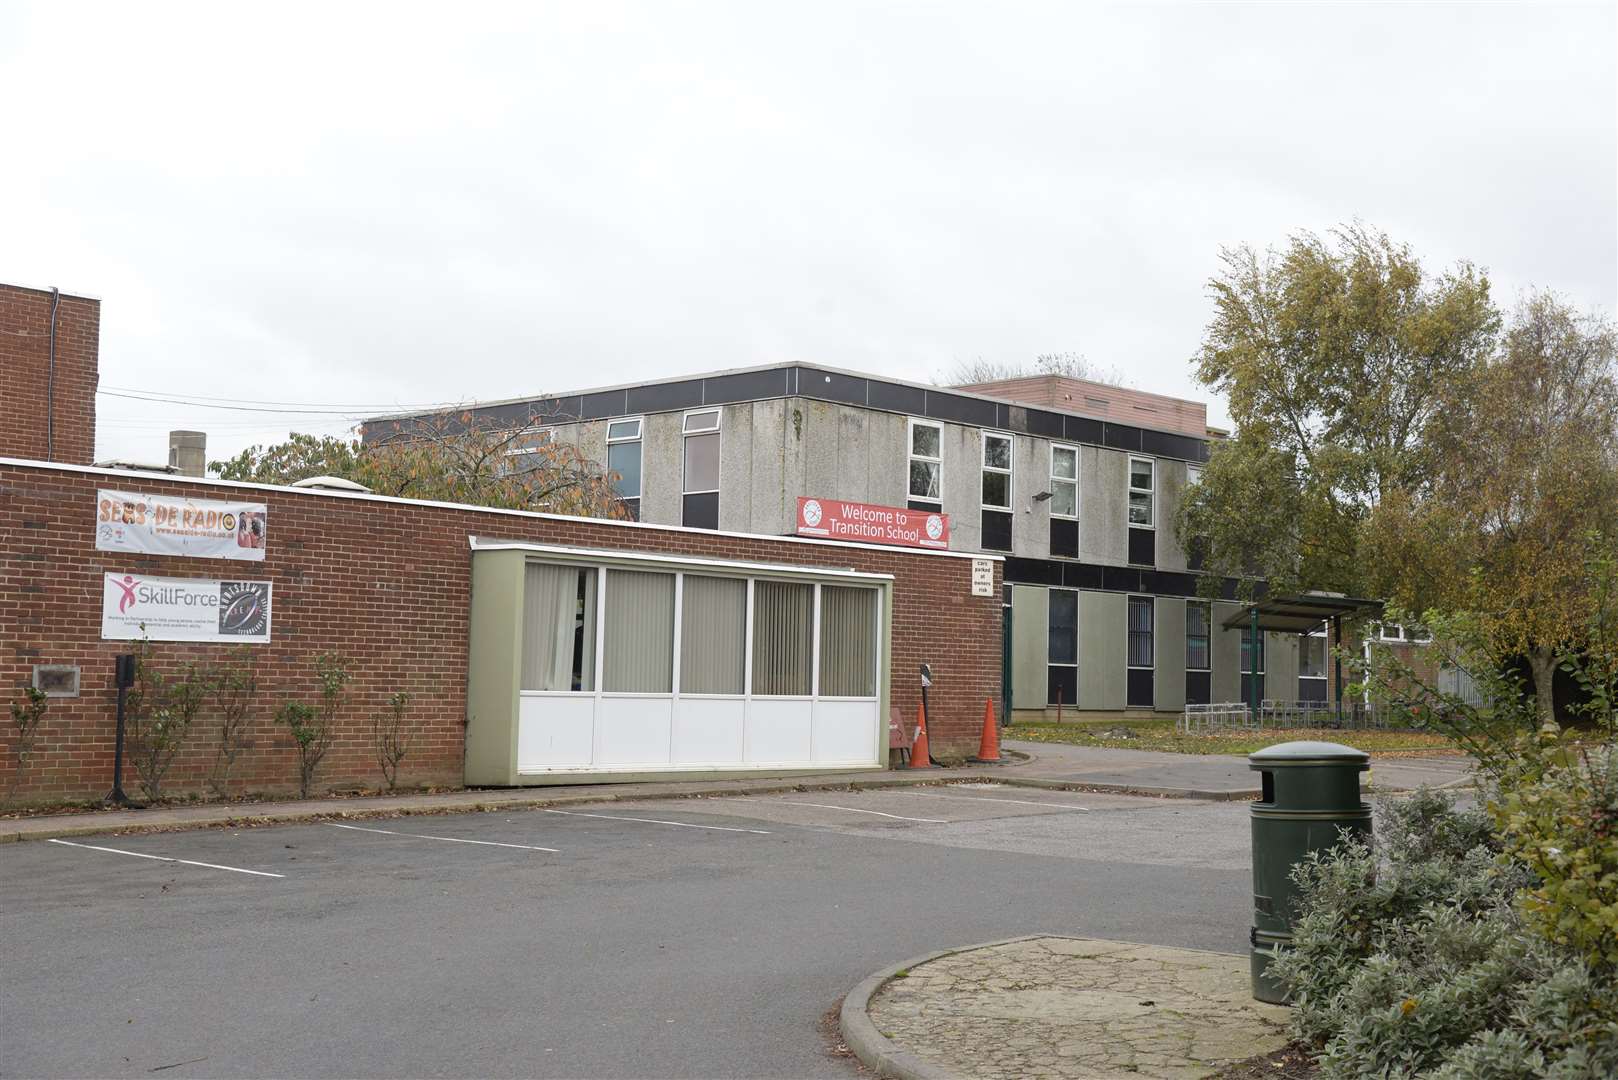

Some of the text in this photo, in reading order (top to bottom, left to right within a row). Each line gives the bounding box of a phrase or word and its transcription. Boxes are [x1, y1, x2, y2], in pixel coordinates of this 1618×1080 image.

[182, 509, 236, 531] RADIO
[841, 504, 907, 526] Welcome to
[830, 518, 885, 537] Transition
[887, 526, 919, 542] School
[138, 586, 219, 607] SkillForce
